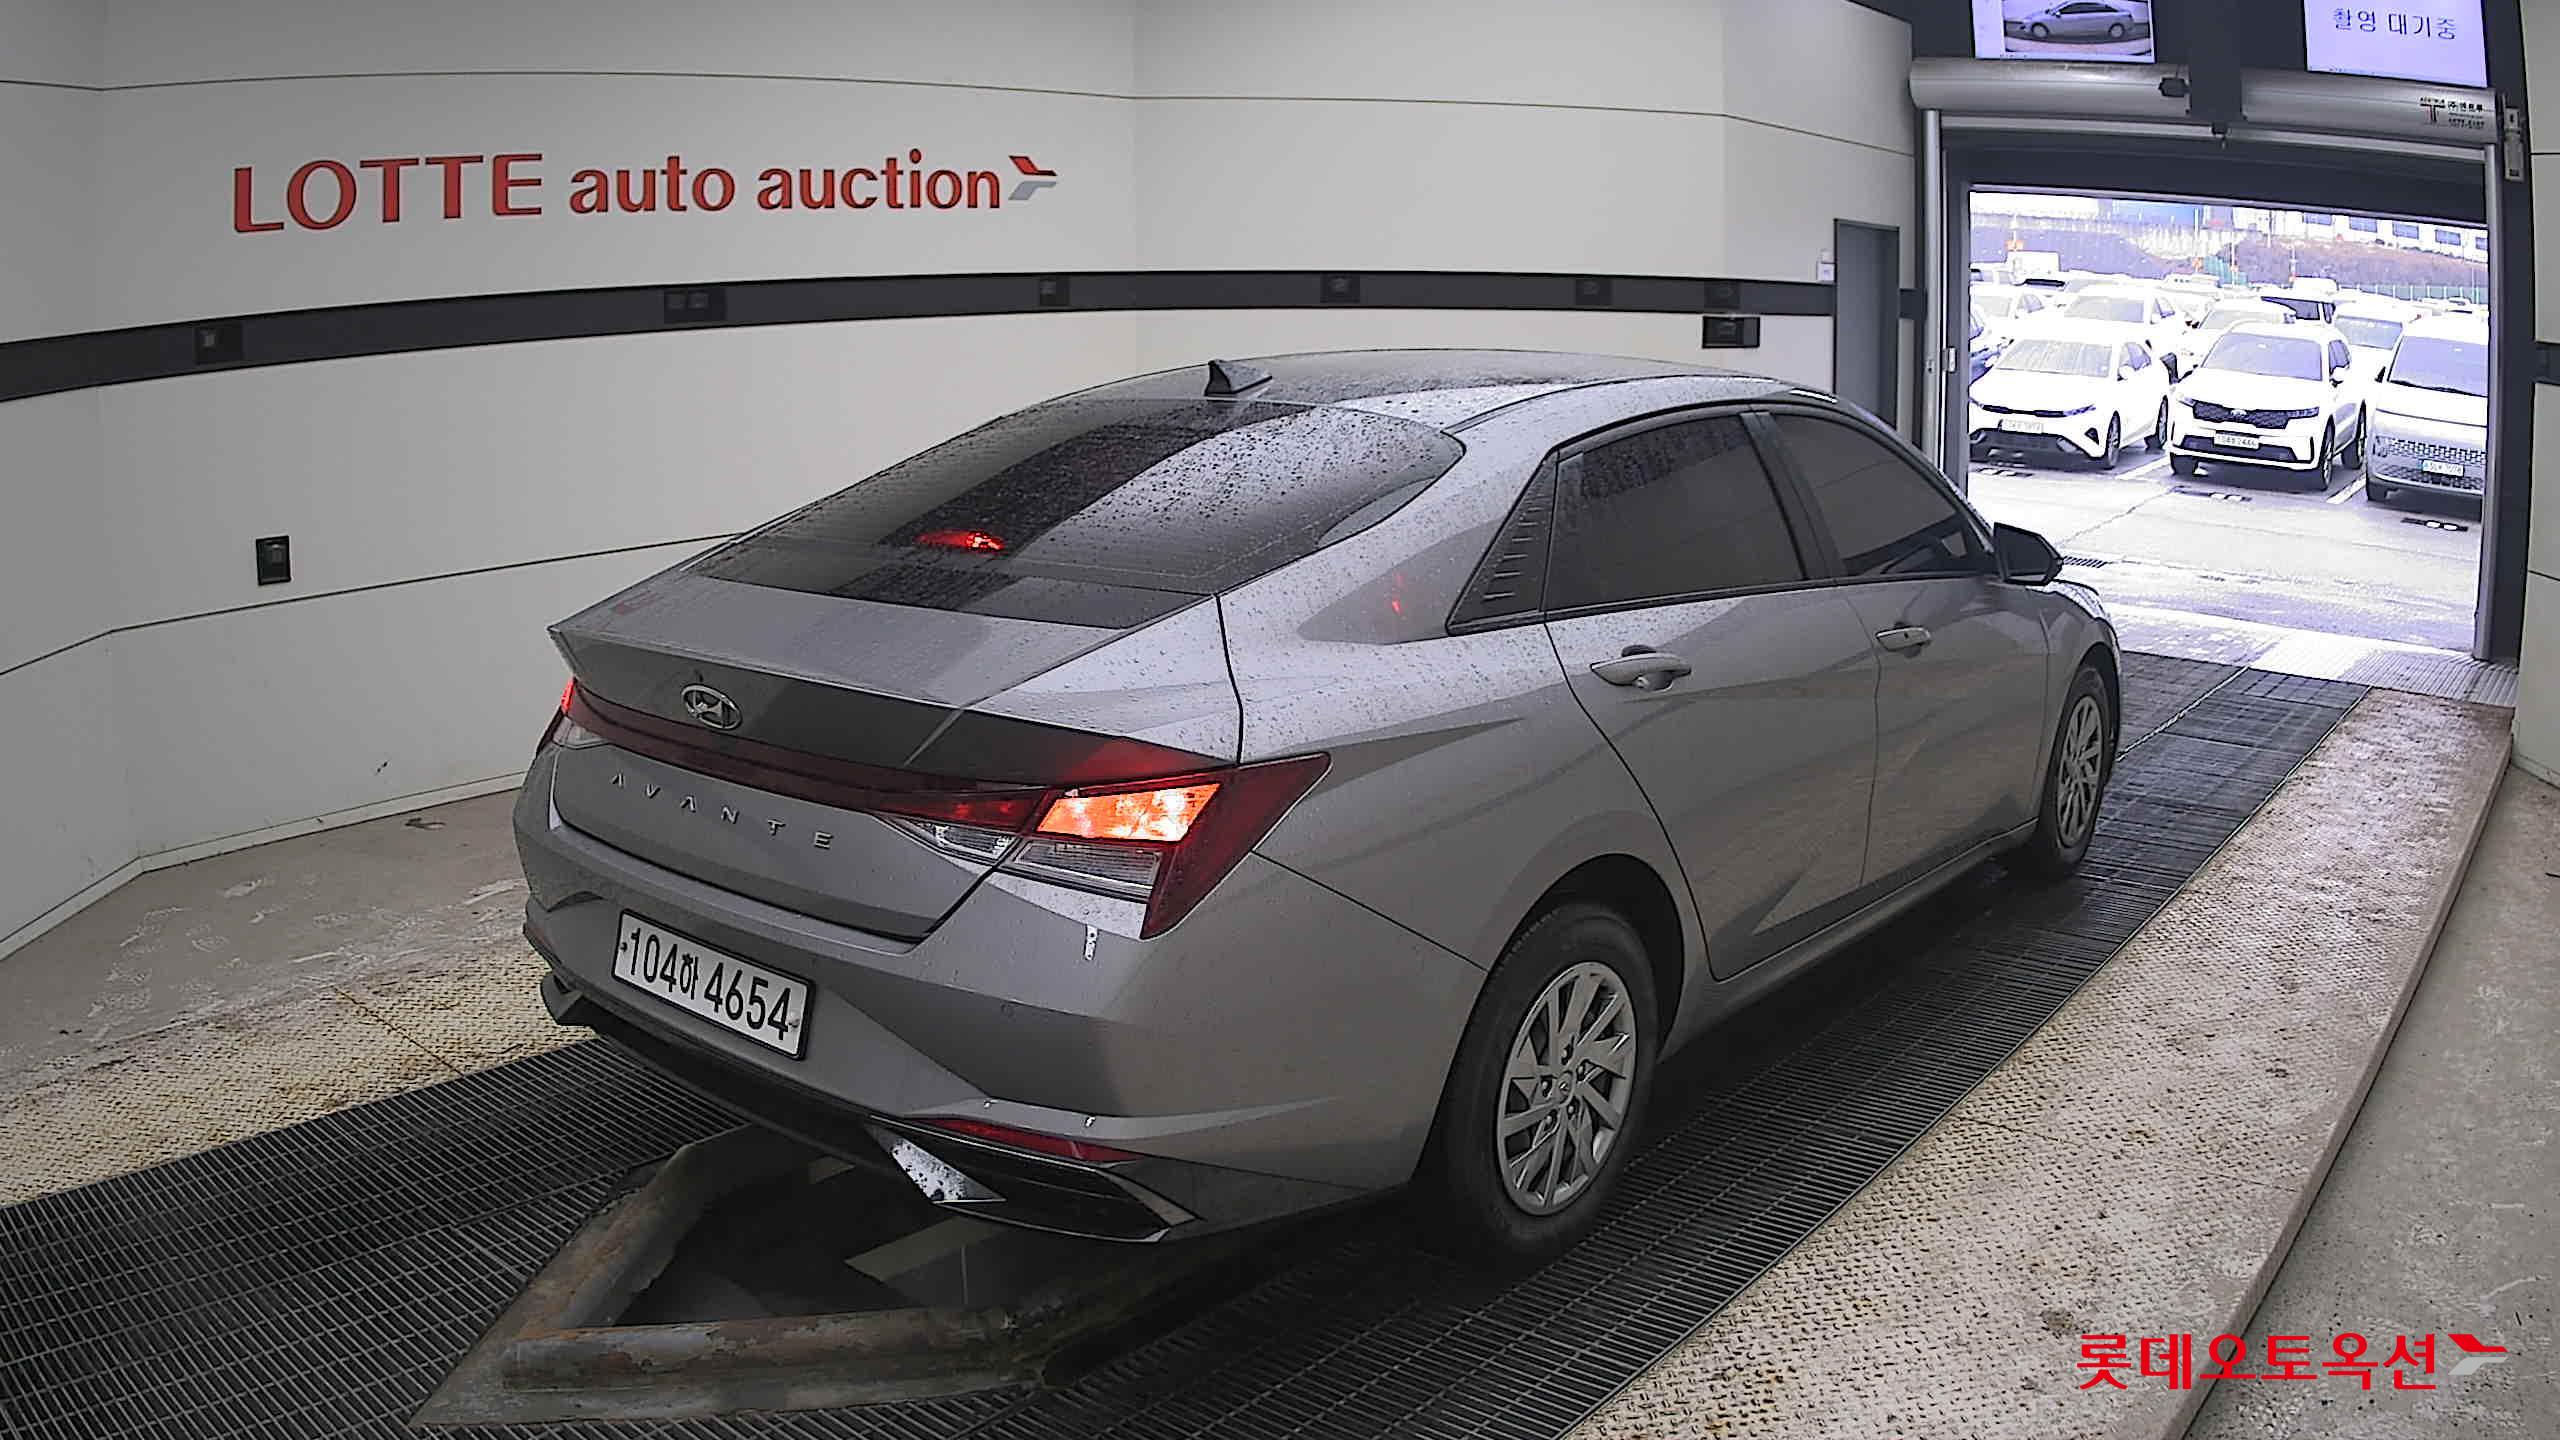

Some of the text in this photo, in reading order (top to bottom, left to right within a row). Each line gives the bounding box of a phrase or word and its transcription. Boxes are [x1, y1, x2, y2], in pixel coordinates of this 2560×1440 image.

[2388, 13, 2456, 41] 대기중
[234, 149, 1002, 232] LOTTE auto auction
[611, 772, 834, 850] AVANTE
